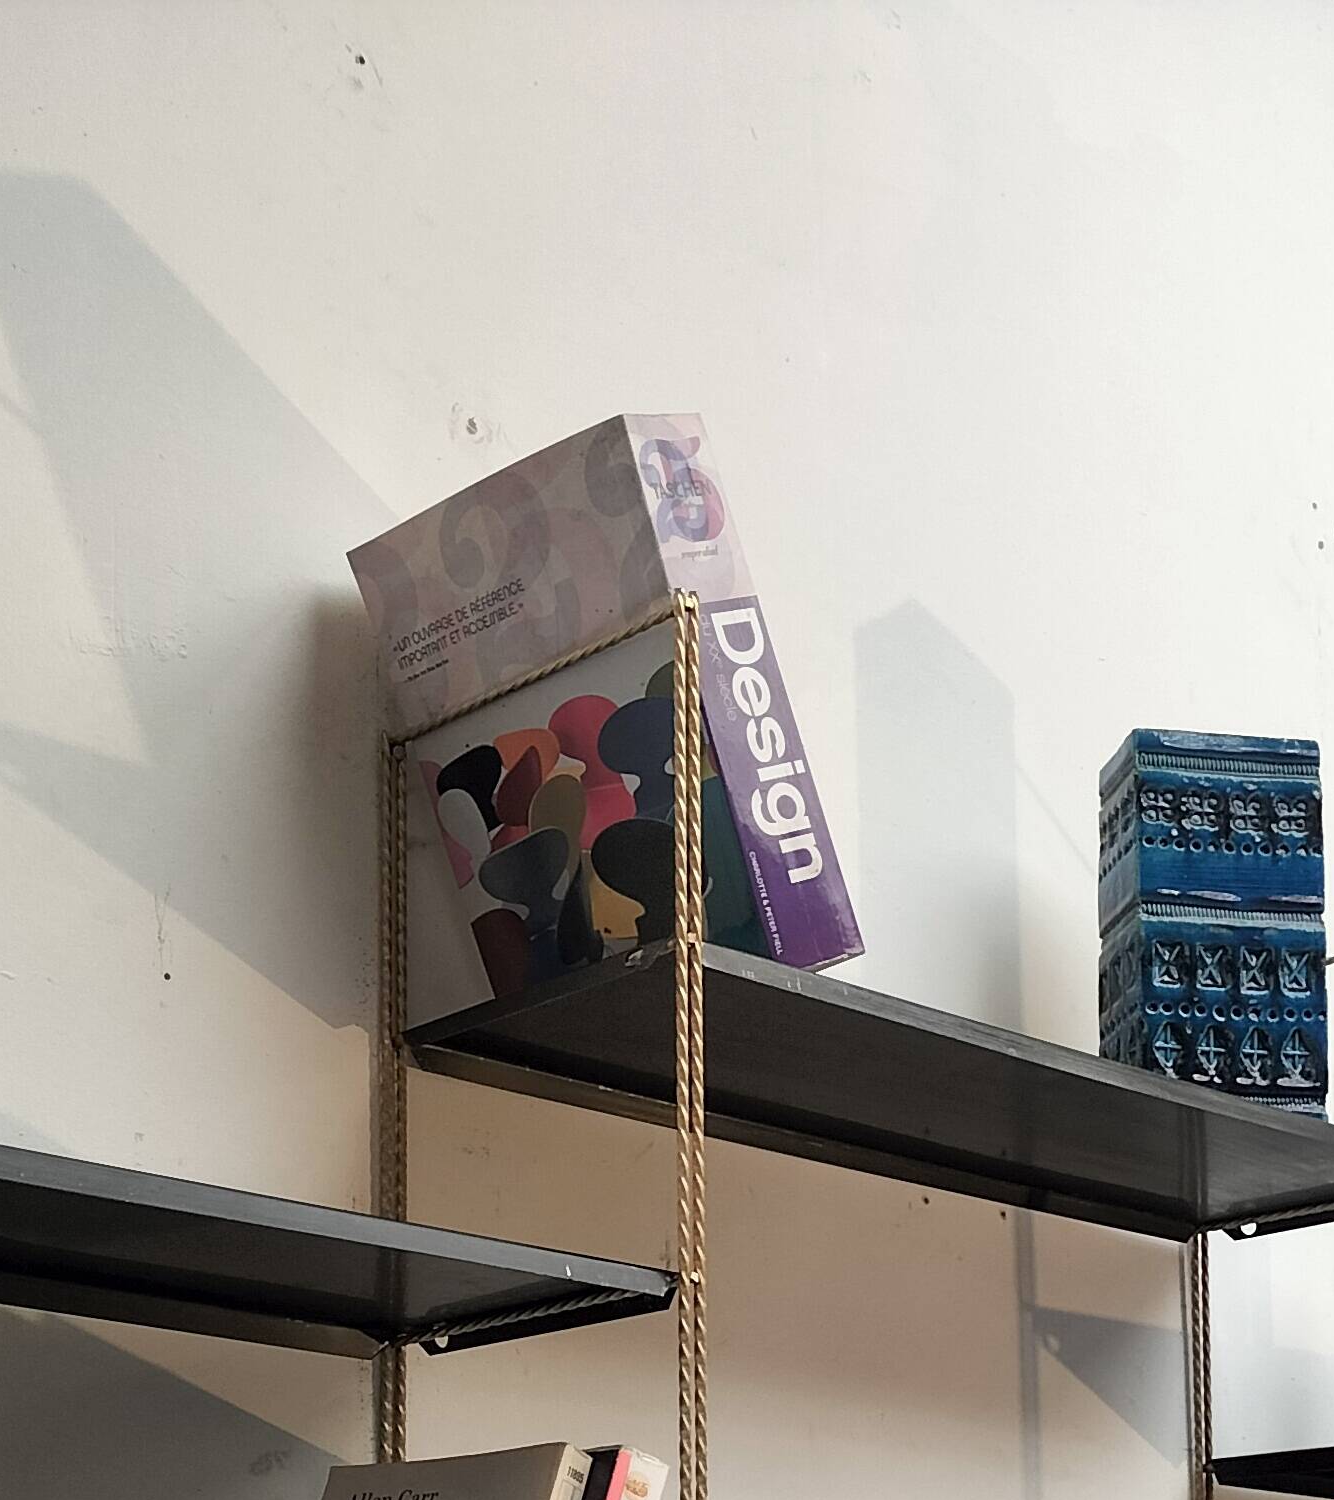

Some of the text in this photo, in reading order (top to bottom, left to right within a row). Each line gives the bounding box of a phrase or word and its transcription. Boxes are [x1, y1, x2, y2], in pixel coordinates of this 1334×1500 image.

[412, 613, 455, 645] OUVRAGE
[455, 606, 470, 623] DE
[397, 634, 448, 670] IMPORTANT
[449, 629, 462, 645] ET
[710, 607, 823, 884] Design
[749, 850, 768, 898] CHARLOTTE
